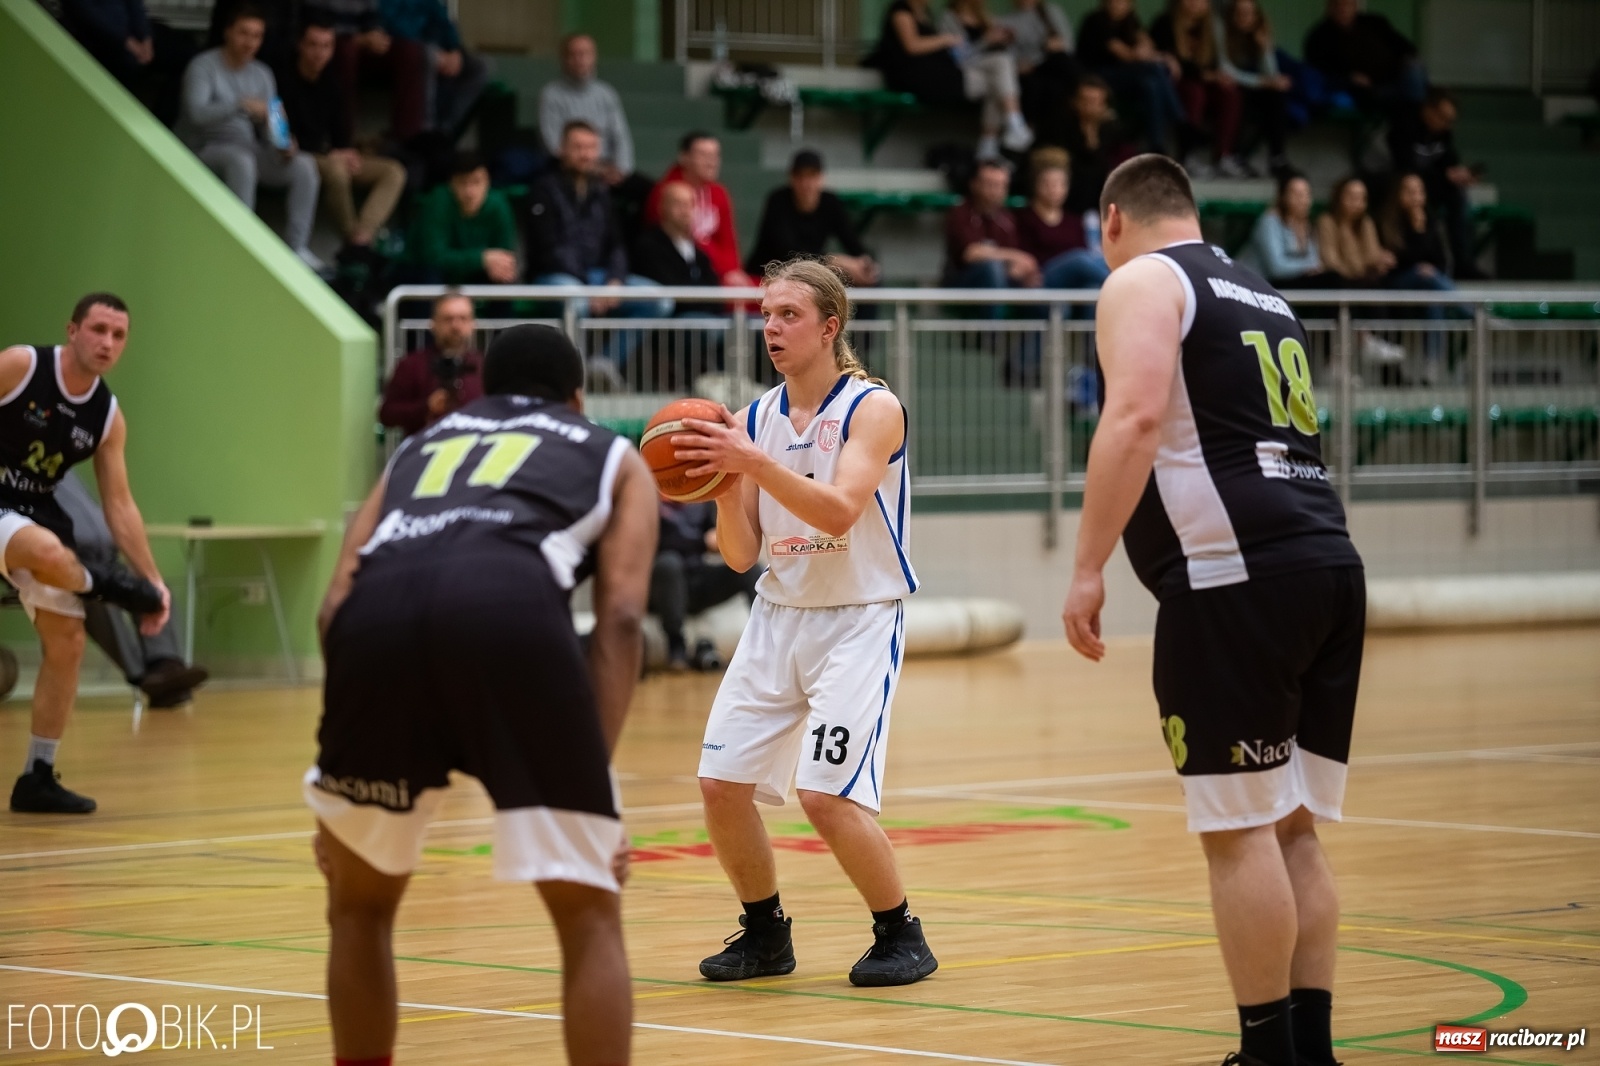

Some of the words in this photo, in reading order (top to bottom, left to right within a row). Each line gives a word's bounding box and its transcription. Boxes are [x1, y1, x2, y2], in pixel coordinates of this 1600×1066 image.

[1240, 330, 1320, 436] 18
[22, 440, 64, 478] 24
[411, 432, 542, 500] 11
[811, 723, 850, 766] 13
[1161, 715, 1188, 769] 8
